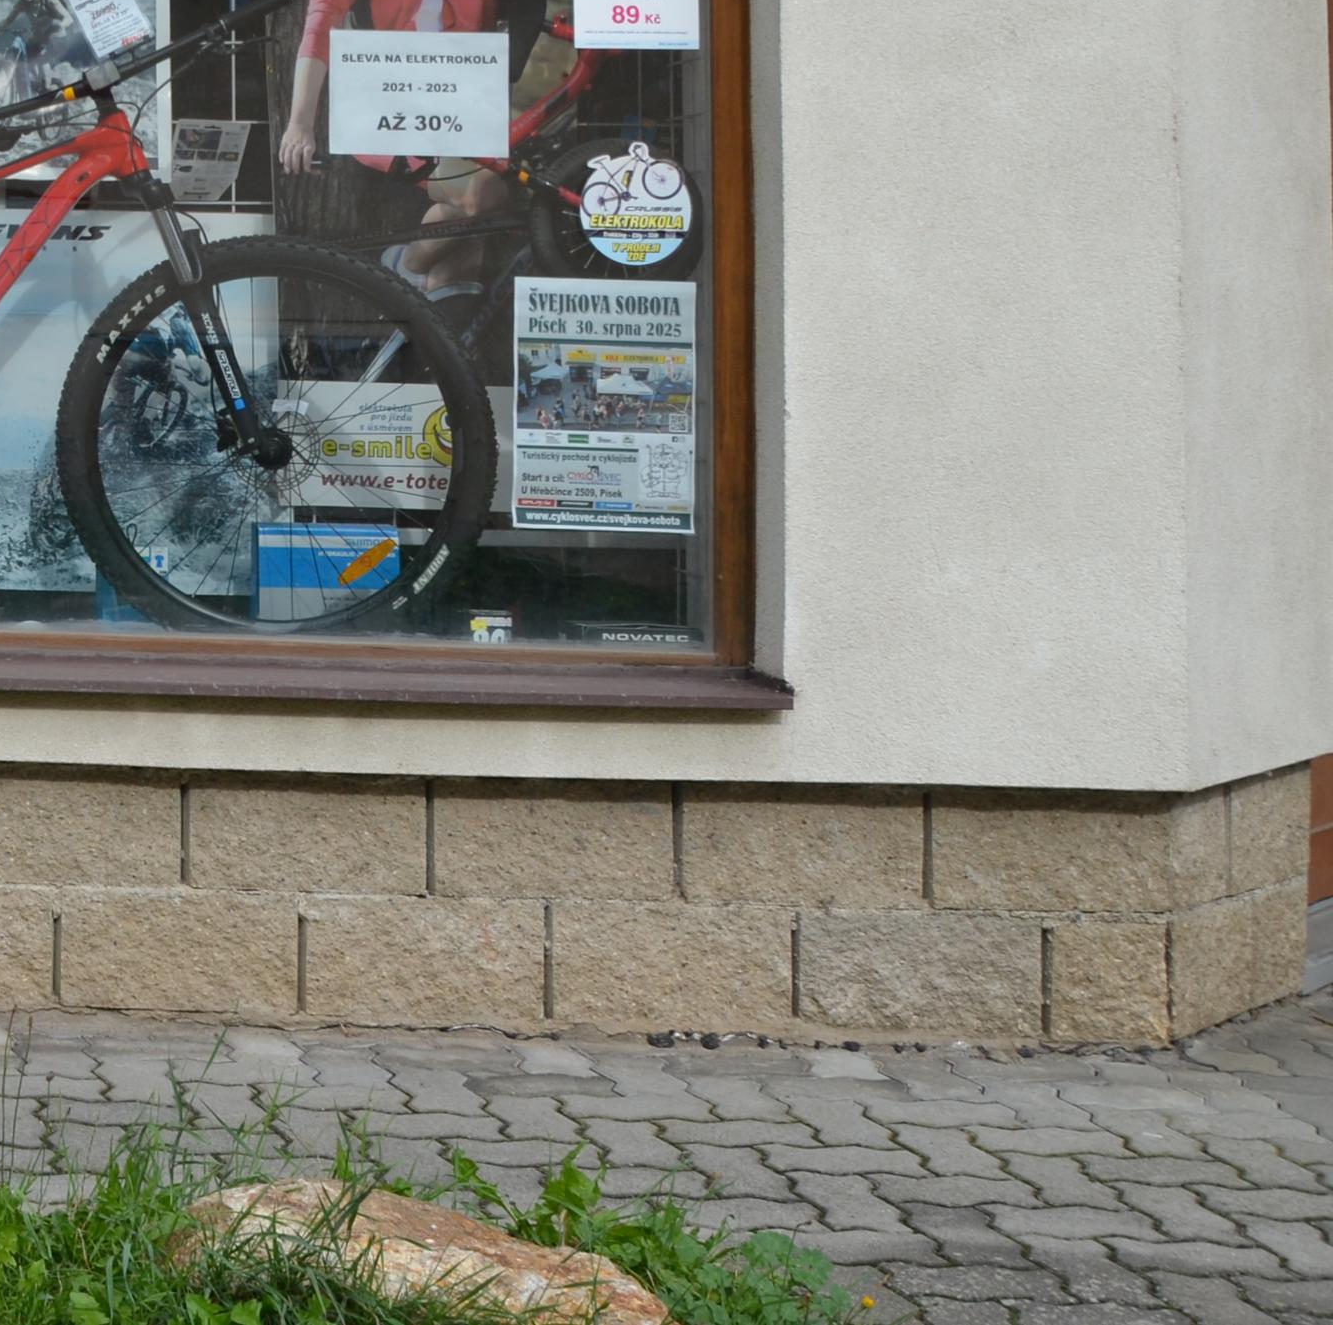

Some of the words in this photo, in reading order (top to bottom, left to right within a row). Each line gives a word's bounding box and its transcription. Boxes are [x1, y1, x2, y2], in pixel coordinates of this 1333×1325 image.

[611, 4, 641, 25] 89
[644, 14, 661, 25] Kč
[341, 53, 381, 64] SLEVA
[385, 54, 402, 64] NA
[406, 54, 498, 65] ELEKTROKOLA
[381, 82, 413, 93] 2021
[426, 83, 457, 94] 2023
[376, 112, 407, 132] AŽ
[414, 115, 463, 133] 30%
[589, 215, 684, 230] ELEKTROKOLA
[528, 286, 611, 315] ŠVEJKOVA
[614, 294, 681, 317] SOBOTA
[95, 283, 167, 365] MAXXIS
[528, 315, 568, 334] Písek
[575, 319, 598, 335] 30.
[602, 322, 642, 338] srpna
[645, 321, 682, 338] 2025
[320, 435, 433, 461] e-smile
[320, 472, 449, 491] www.e-tote
[601, 632, 690, 643] NOVATEC
